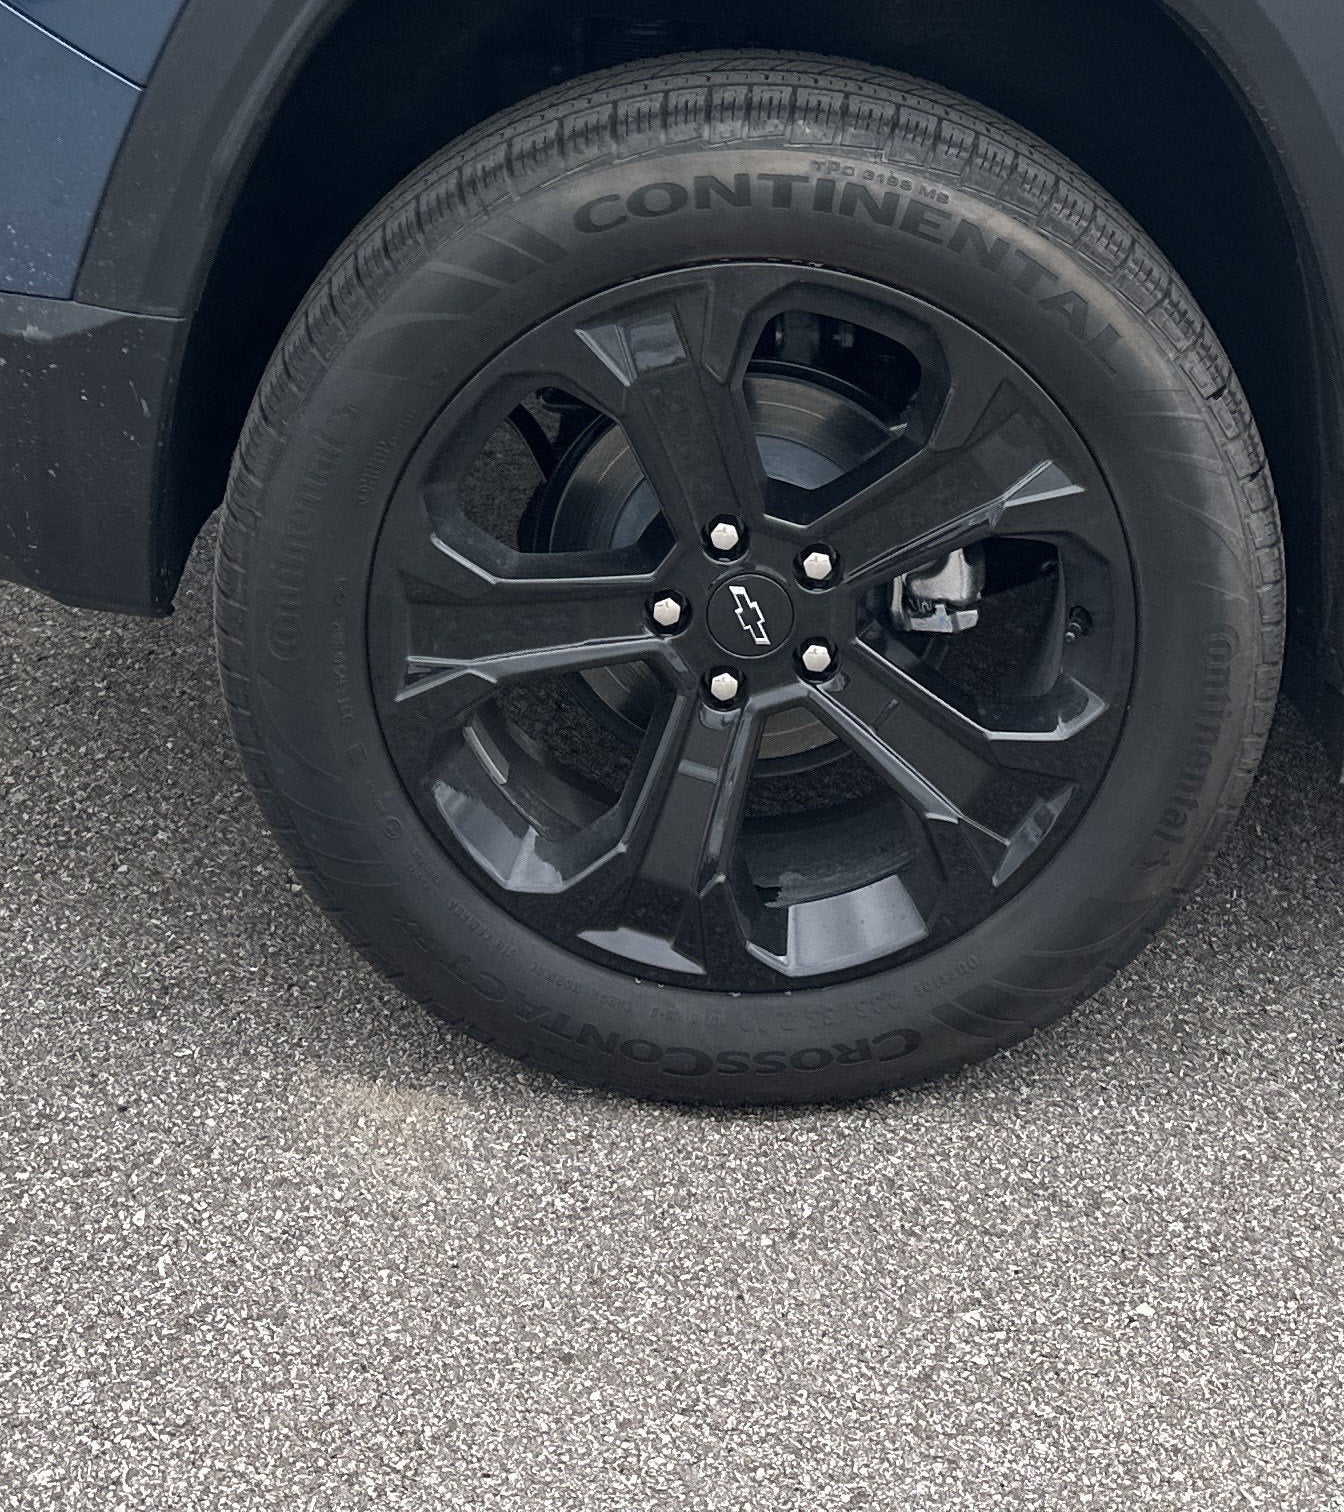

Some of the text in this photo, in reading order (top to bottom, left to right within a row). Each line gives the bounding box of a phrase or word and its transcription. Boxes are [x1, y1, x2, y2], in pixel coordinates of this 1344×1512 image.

[571, 172, 1120, 378] CONTINENTAL
[811, 160, 856, 177] TPC
[917, 183, 950, 205] MS
[1152, 622, 1242, 845] Continental
